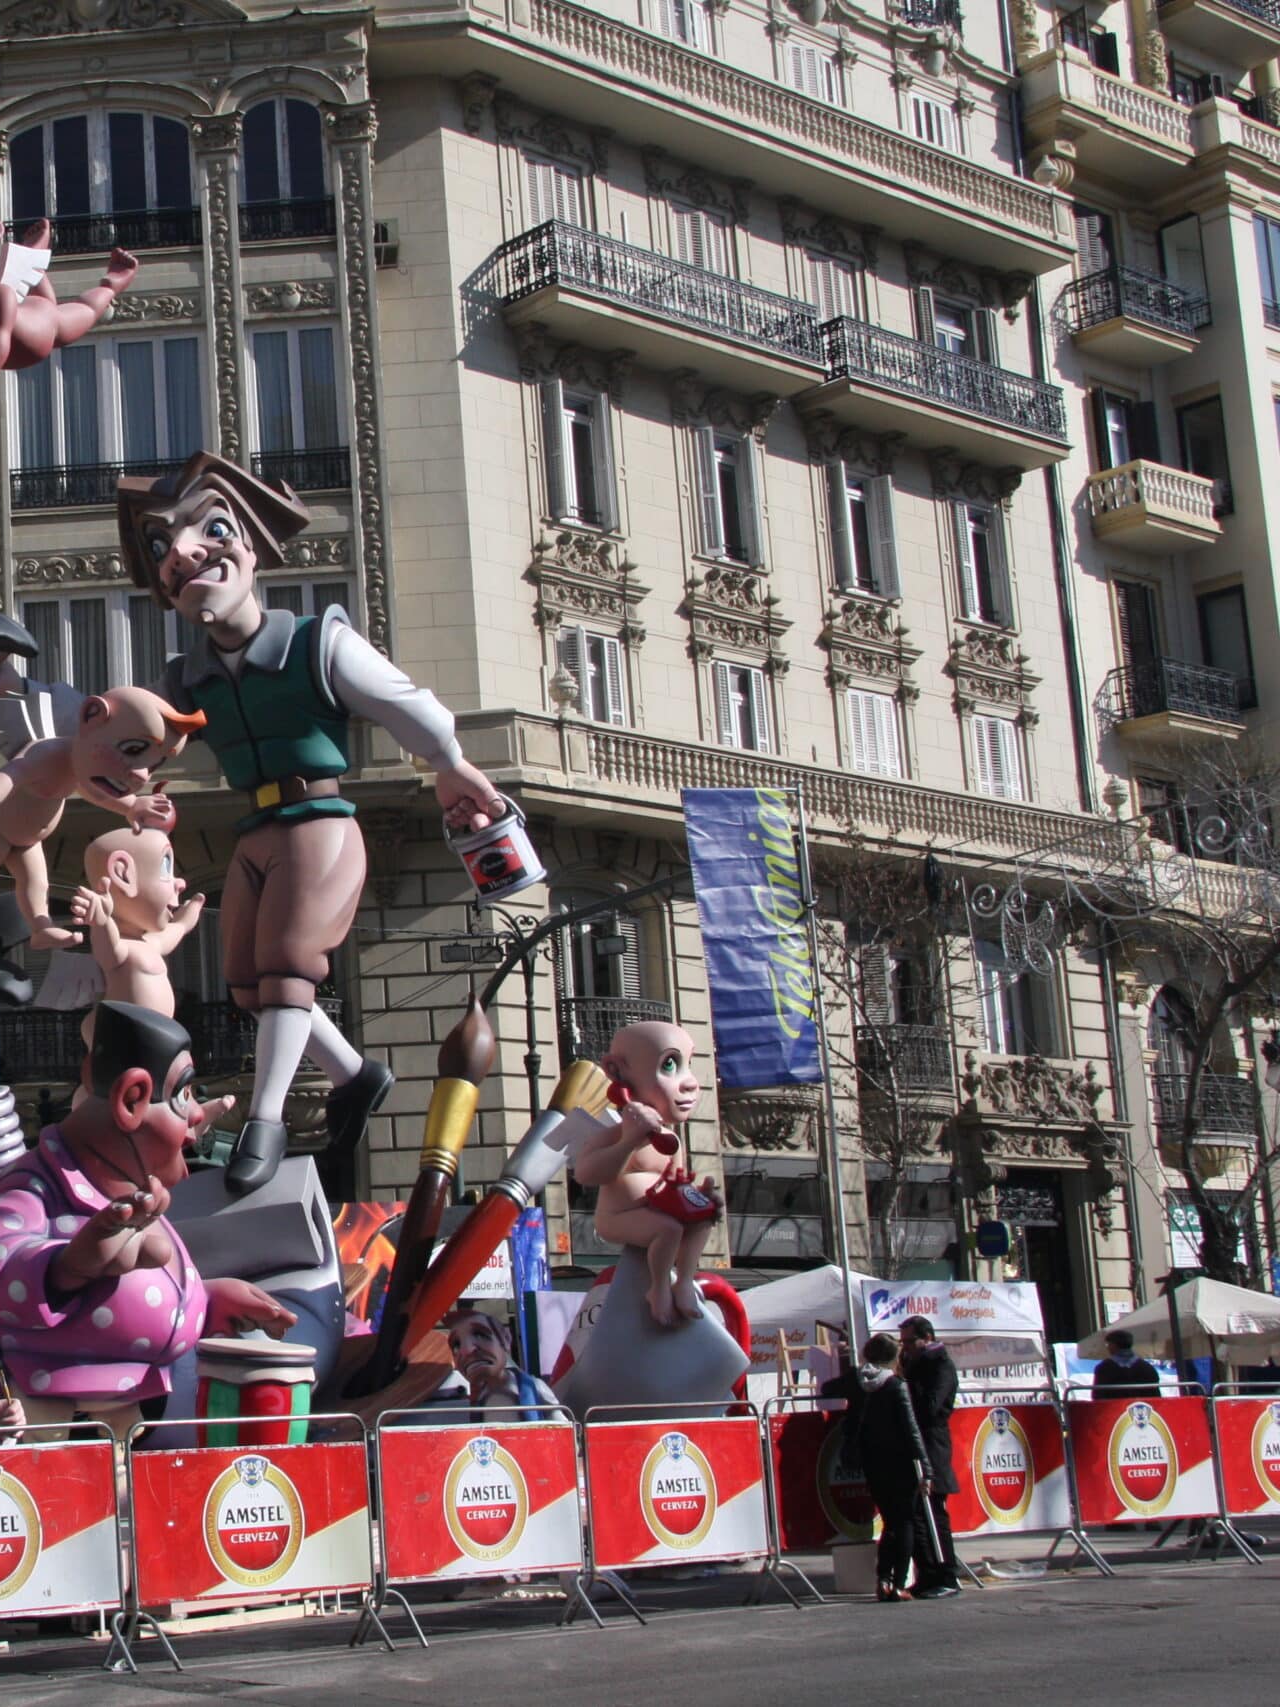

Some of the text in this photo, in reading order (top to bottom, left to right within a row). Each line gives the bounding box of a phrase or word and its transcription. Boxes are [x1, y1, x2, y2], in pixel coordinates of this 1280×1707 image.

[1122, 1446, 1163, 1461] AMSTEL
[985, 1453, 1023, 1469] AMSTEL
[1127, 1467, 1161, 1478] CERVEZA
[656, 1478, 701, 1494] AMSTEL
[989, 1475, 1020, 1486] CERVEZA
[462, 1484, 511, 1502] AMSTEL
[661, 1501, 698, 1511] CERVEZA
[225, 1505, 284, 1524] AMSTEL
[466, 1509, 507, 1520] CERVEZA
[230, 1531, 279, 1544] CERVEZA
